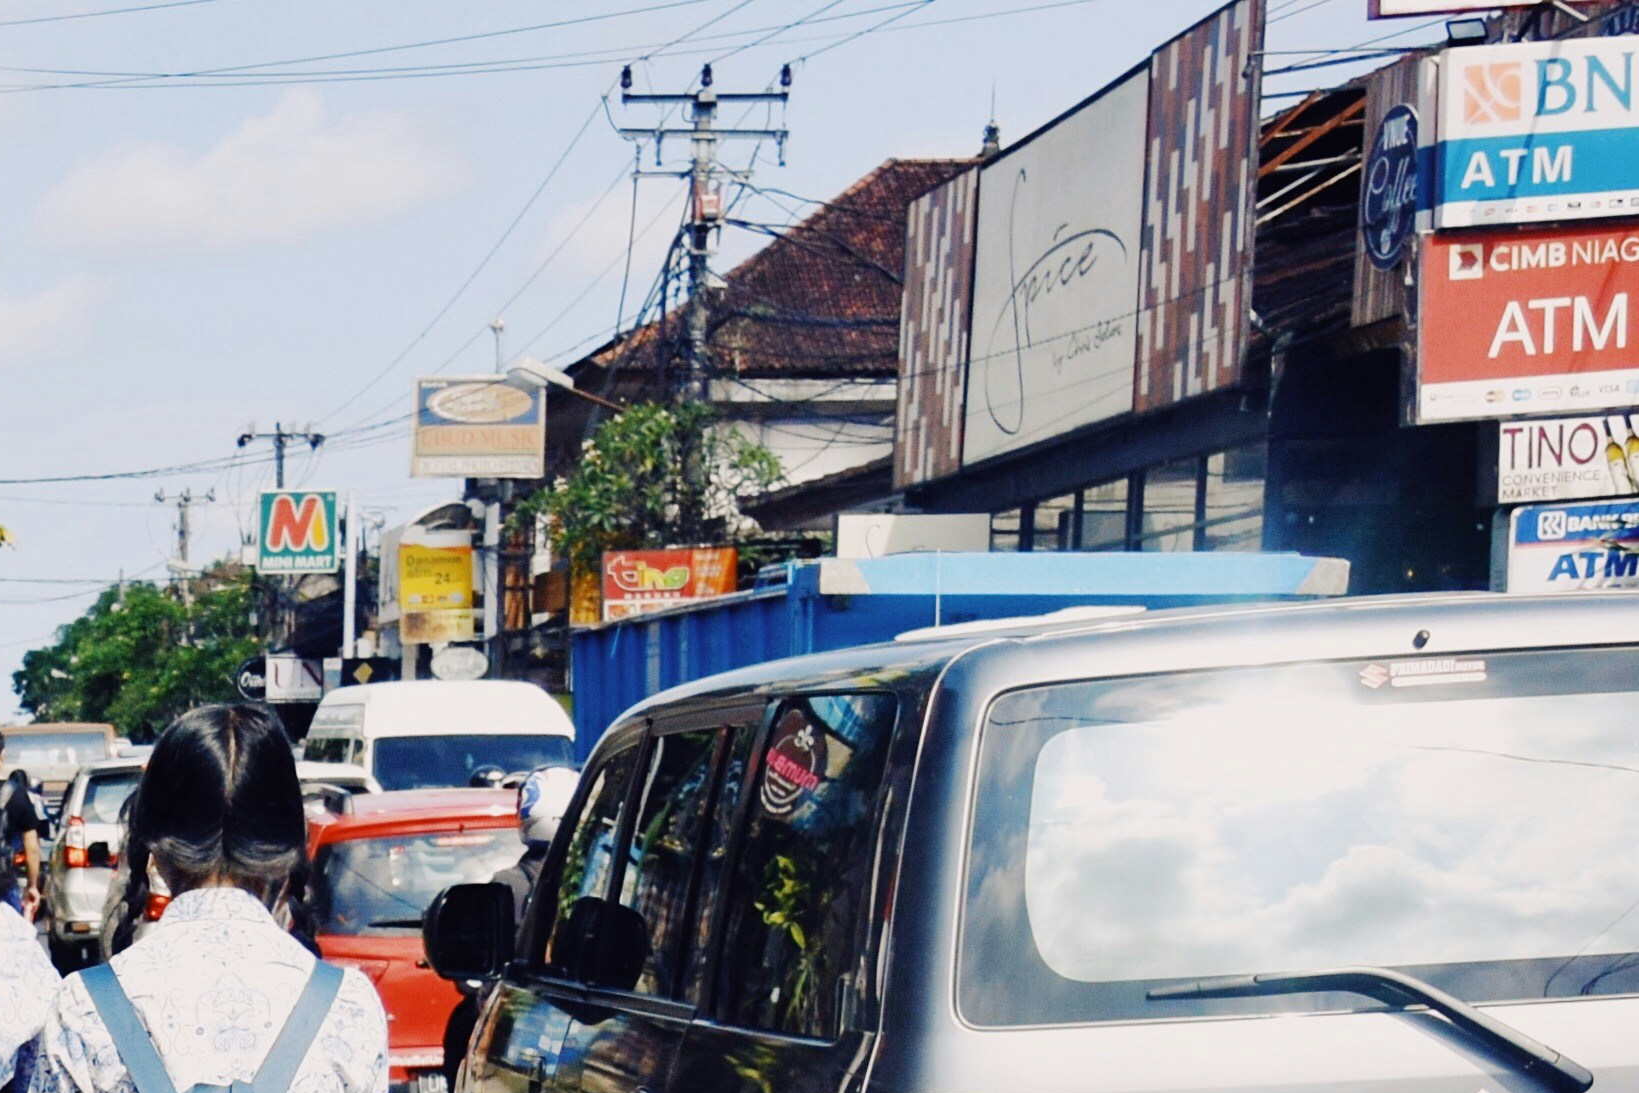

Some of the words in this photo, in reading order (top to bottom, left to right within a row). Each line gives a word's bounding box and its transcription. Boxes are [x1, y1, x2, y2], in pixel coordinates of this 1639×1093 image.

[1534, 52, 1636, 117] BN
[1461, 145, 1574, 190] ATM
[1489, 242, 1567, 273] CIMB
[1488, 292, 1628, 359] ATM
[1599, 384, 1620, 394] VISA
[1502, 423, 1598, 470] TINO
[1502, 469, 1601, 486] CONVENIENCE
[1502, 485, 1558, 499] MARKET
[1568, 514, 1620, 533] BANK
[262, 556, 294, 568] MINI
[294, 556, 333, 568] MART
[1547, 551, 1639, 582] ATM
[434, 572, 451, 585] 24
